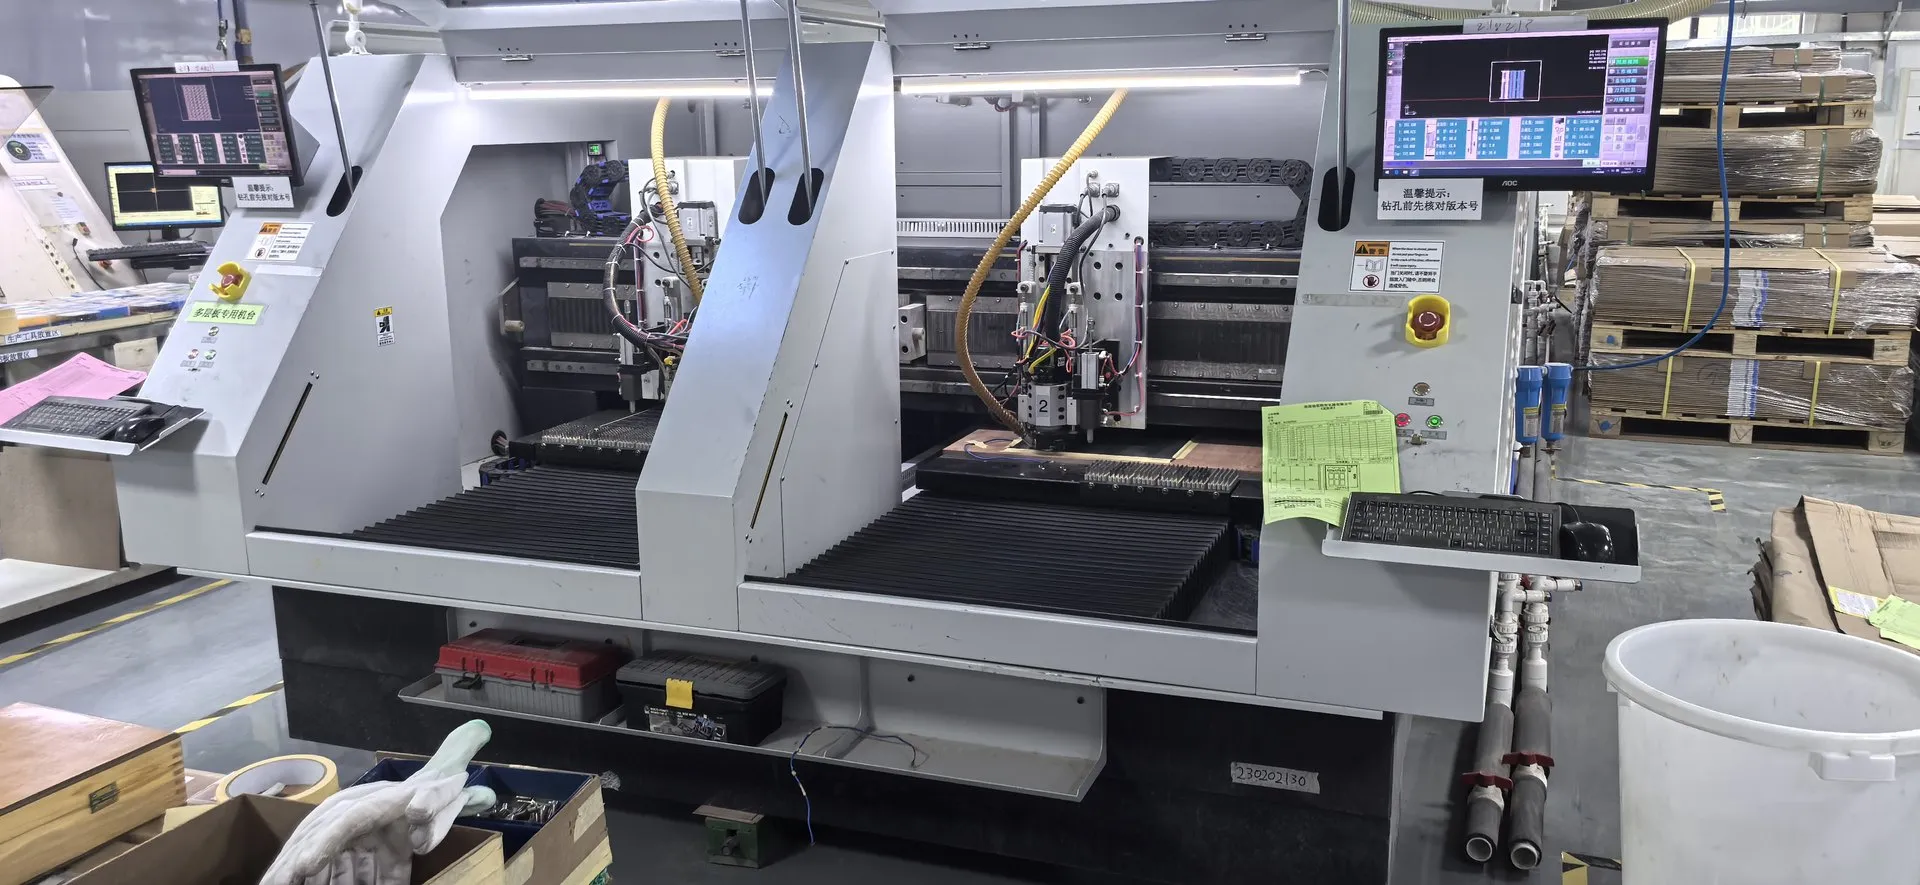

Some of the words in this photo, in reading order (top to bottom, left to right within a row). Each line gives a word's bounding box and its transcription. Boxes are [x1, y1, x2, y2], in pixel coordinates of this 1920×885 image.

[1403, 188, 1451, 198] 温馨提示：
[1381, 201, 1478, 211] 钻孔前先核对版本号
[193, 308, 256, 320] 多层板专用机台
[7, 330, 60, 343] 生产工具放置区
[1039, 400, 1048, 412] 2
[1236, 767, 1305, 786] 230202130
